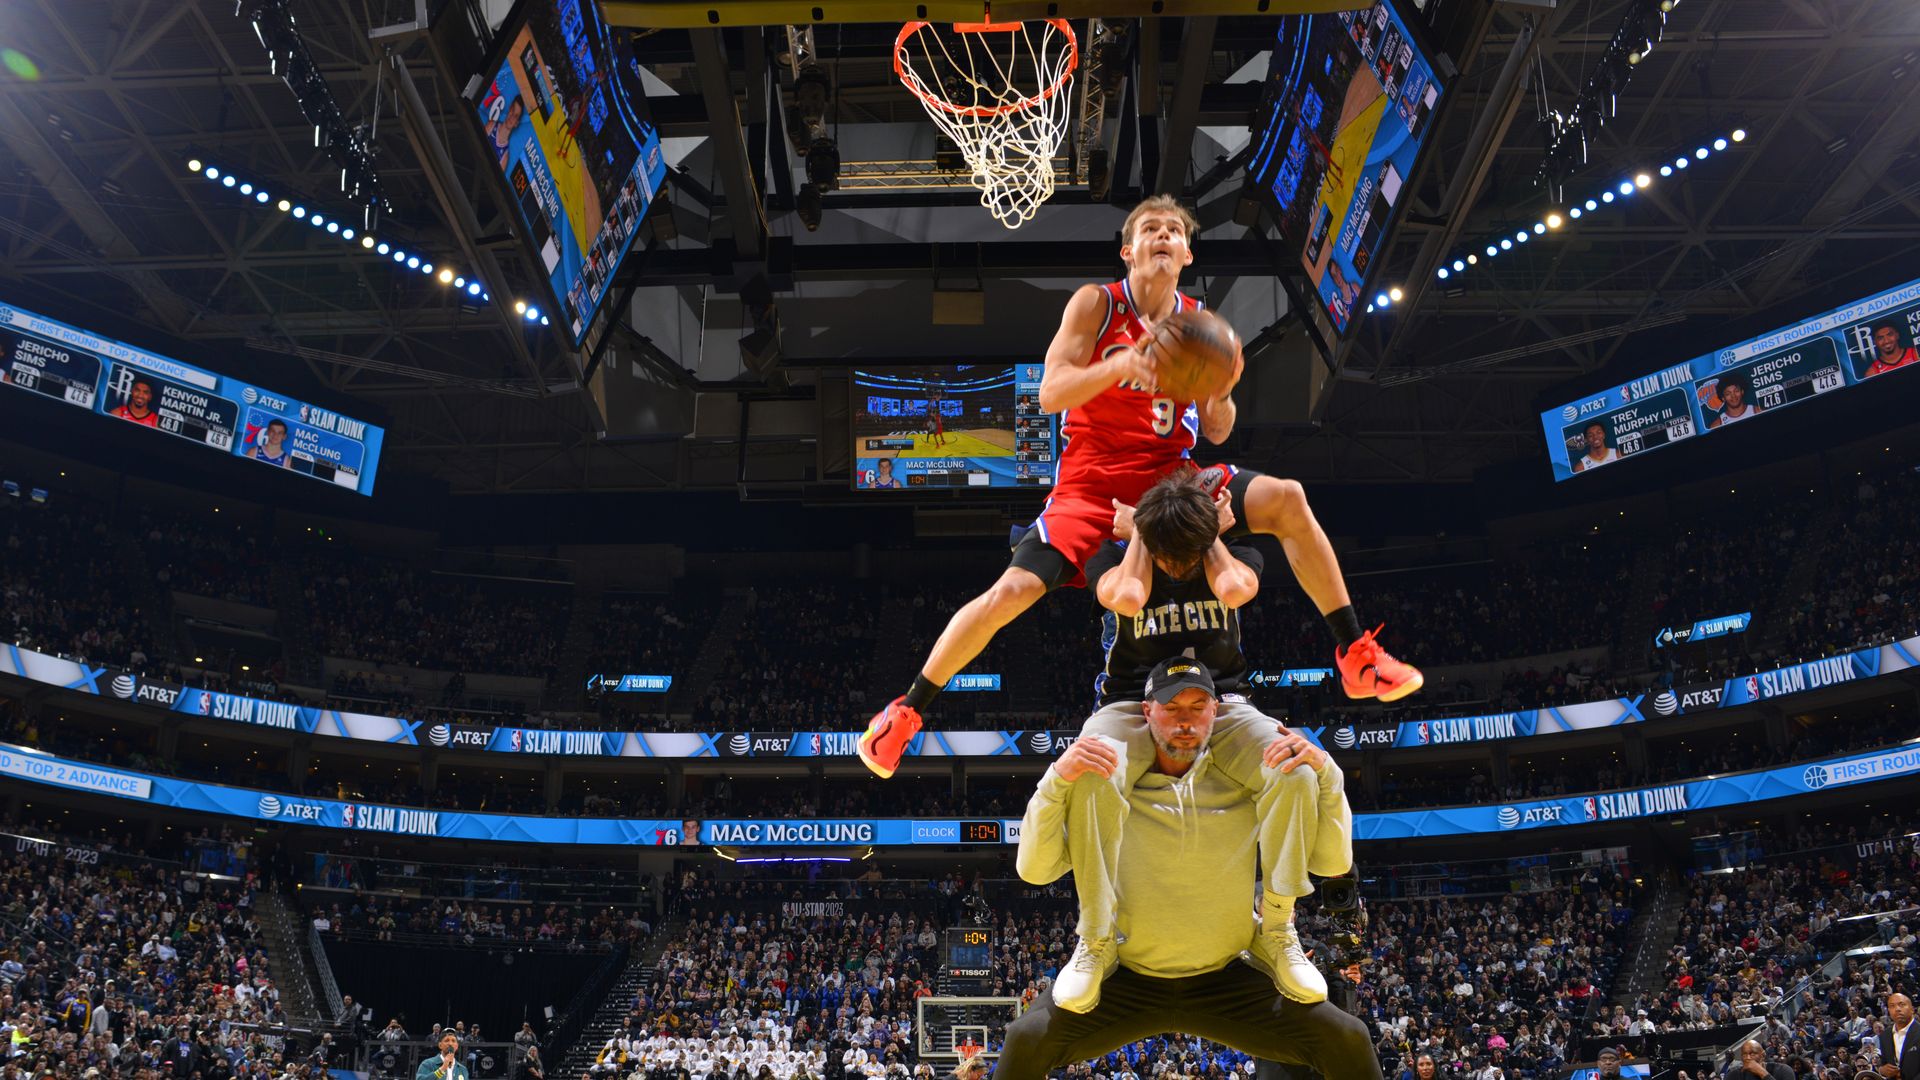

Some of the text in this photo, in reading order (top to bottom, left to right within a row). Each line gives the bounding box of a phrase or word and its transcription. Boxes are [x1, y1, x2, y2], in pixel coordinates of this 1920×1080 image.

[525, 136, 559, 219] MAC McCLUNG
[1379, 165, 1388, 181] TOTAL
[1340, 176, 1372, 253] MAC McCLUNG
[1117, 302, 1126, 314] 6
[1750, 335, 1781, 354] FIRST
[1784, 321, 1823, 342] ROUND
[1831, 310, 1854, 326] TOP
[1857, 306, 1865, 316] 2
[17, 339, 71, 364] JERICHO
[29, 319, 61, 338] FIRST
[62, 329, 100, 351] ROUND
[108, 345, 129, 362] TOP
[130, 352, 138, 363] 2
[138, 355, 188, 378] ADVANCE
[14, 350, 46, 368] SIMS
[1750, 352, 1802, 378] JERICHO
[14, 371, 35, 388] 47.6
[1752, 370, 1784, 389] SIMS
[1813, 366, 1836, 377] TOTAL
[72, 381, 91, 392] TOTAL
[1580, 363, 1693, 416] AT&T SLAM DUNK
[1818, 374, 1838, 390] 47.6
[70, 388, 89, 404] 47.6
[162, 385, 208, 407] KENYON
[1758, 386, 1775, 397] DUNK
[160, 396, 205, 418] MARTIN
[206, 410, 222, 424] JR.
[1763, 393, 1782, 410] 47.6
[159, 416, 180, 433] 46.0
[258, 395, 366, 441] AT&T SLAM DUNK
[1151, 398, 1176, 438] 9
[1610, 408, 1639, 425] TREY
[1613, 408, 1673, 436] MURPHY III
[1668, 417, 1688, 427] TOTAL
[212, 424, 230, 435] TOTAL
[295, 428, 319, 443] MAC
[1619, 433, 1633, 443] DUNK
[1671, 423, 1690, 439] 46.6
[210, 432, 228, 448] 46.0
[1622, 439, 1640, 455] 46.6
[292, 437, 341, 461] McCLUNG
[340, 464, 356, 474] TOTAL
[905, 461, 965, 469] MAC McCLUNG
[857, 470, 875, 483] 76
[911, 476, 925, 484] 1:04
[1134, 599, 1230, 640] GATE CITY
[1673, 618, 1743, 639] AT&T SLAM DUNK
[631, 678, 648, 689] SLAM
[648, 678, 664, 689] DUNK
[961, 677, 993, 688] SLAM DUNK
[1293, 672, 1309, 683] SLAM
[1681, 655, 1857, 708] AT&T SLAM DUNK
[136, 684, 296, 729] AT&T SLAM DUNK
[1359, 715, 1516, 744] AT&T SLAM DUNK
[452, 730, 604, 755] AT&T SLAM DUNK
[753, 733, 860, 756] AT&T SLAM
[1055, 737, 1080, 750] AT
[1832, 753, 1920, 779] FIRST ROU
[25, 760, 53, 777] TOP
[57, 767, 66, 780] 2
[68, 770, 138, 793] ADVANCE
[1523, 785, 1688, 822] AT&T SLAM DUNK
[283, 803, 438, 835] AT&T SLAM DUNK
[655, 829, 677, 845] 76
[711, 824, 872, 842] MAC McCLUNG
[917, 827, 955, 838] CLOCK
[969, 824, 997, 839] 1:04
[64, 847, 99, 865] 2023
[825, 902, 844, 917] 2023
[965, 932, 987, 944] 1:04
